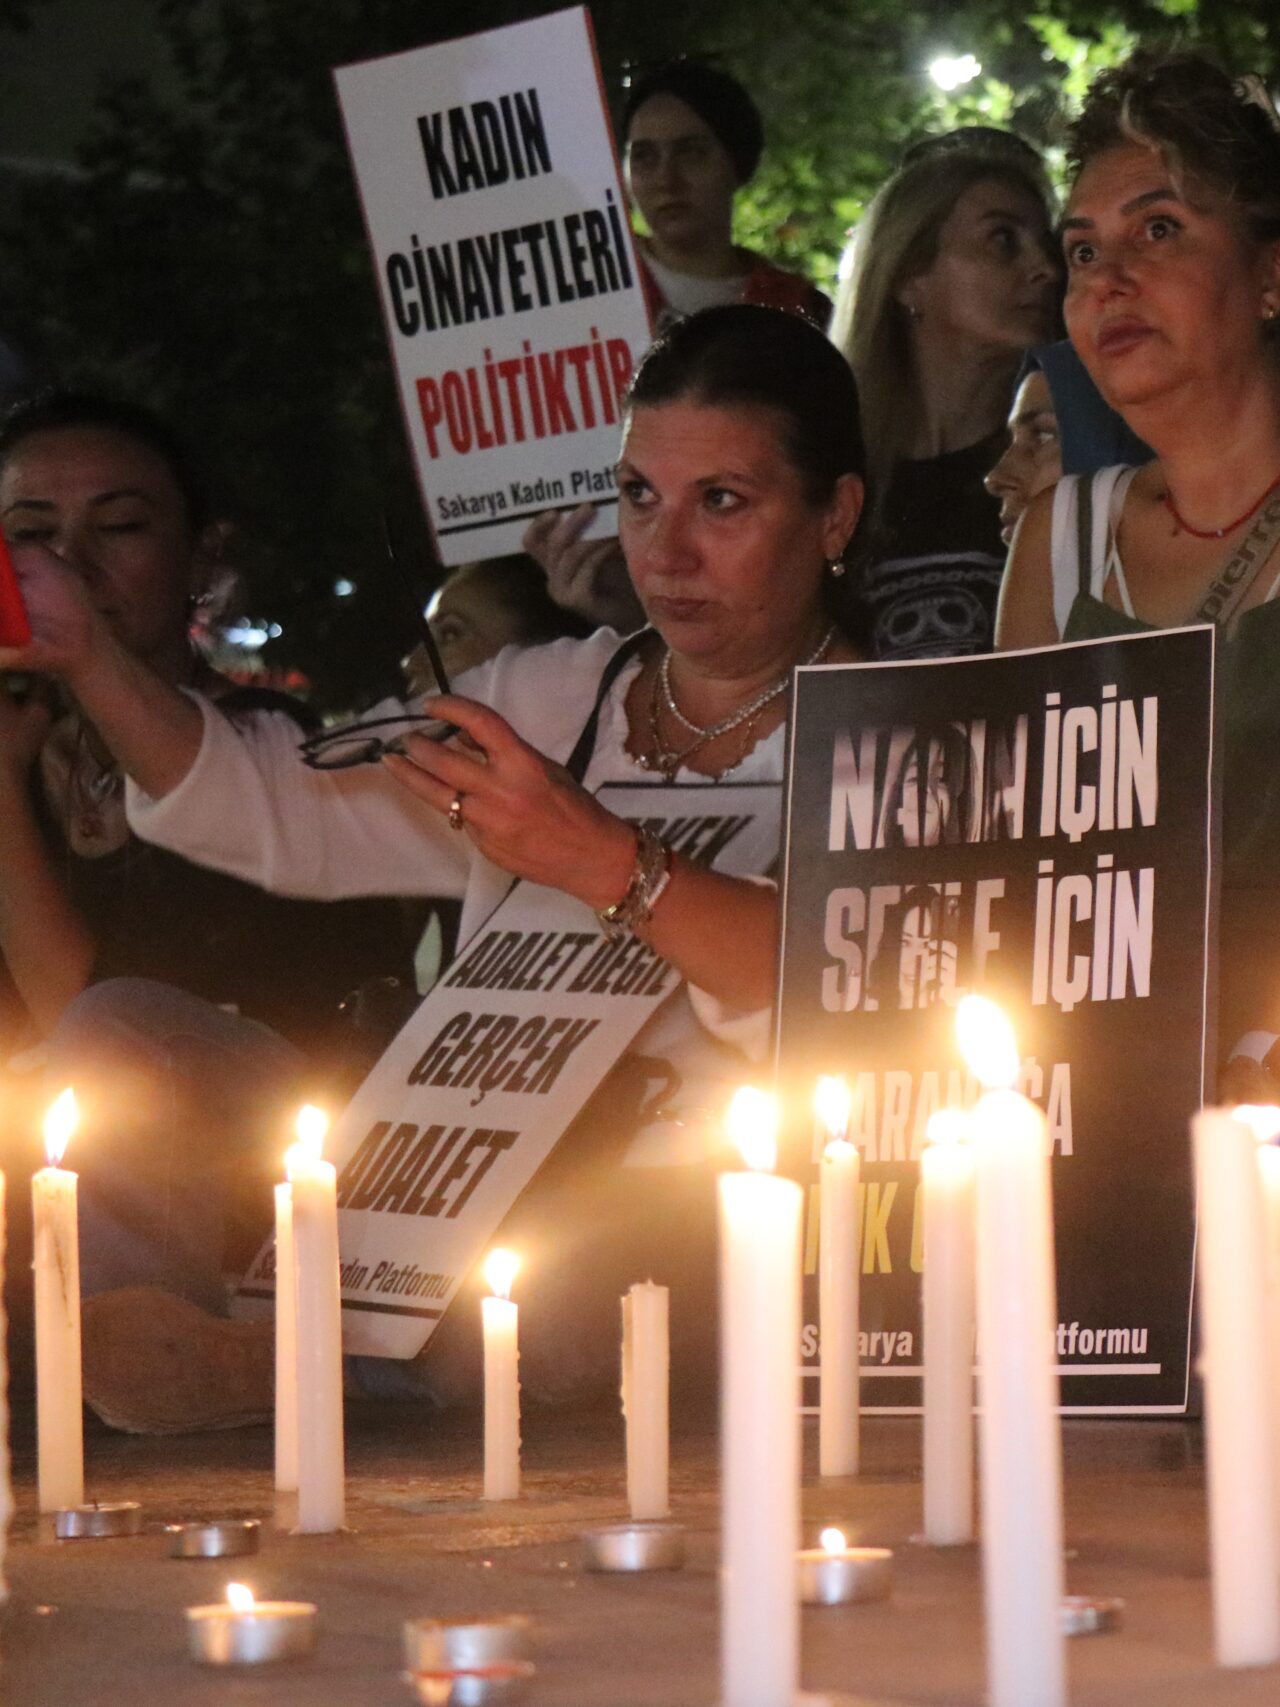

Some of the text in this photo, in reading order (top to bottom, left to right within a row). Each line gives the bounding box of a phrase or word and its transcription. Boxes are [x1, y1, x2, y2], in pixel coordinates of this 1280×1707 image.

[417, 88, 552, 200] KADIN
[386, 188, 633, 337] CİNAYETLERİ
[437, 488, 506, 520] Sakarya
[510, 478, 564, 505] Kadın
[1040, 684, 1158, 843] İÇİN
[444, 931, 601, 992] ADALET
[1031, 854, 1155, 1013] İÇİN
[406, 1011, 602, 1108] GERÇEK
[336, 1120, 521, 1219] ADALET
[365, 1260, 455, 1299] Platformu
[1053, 1321, 1148, 1356] tformu
